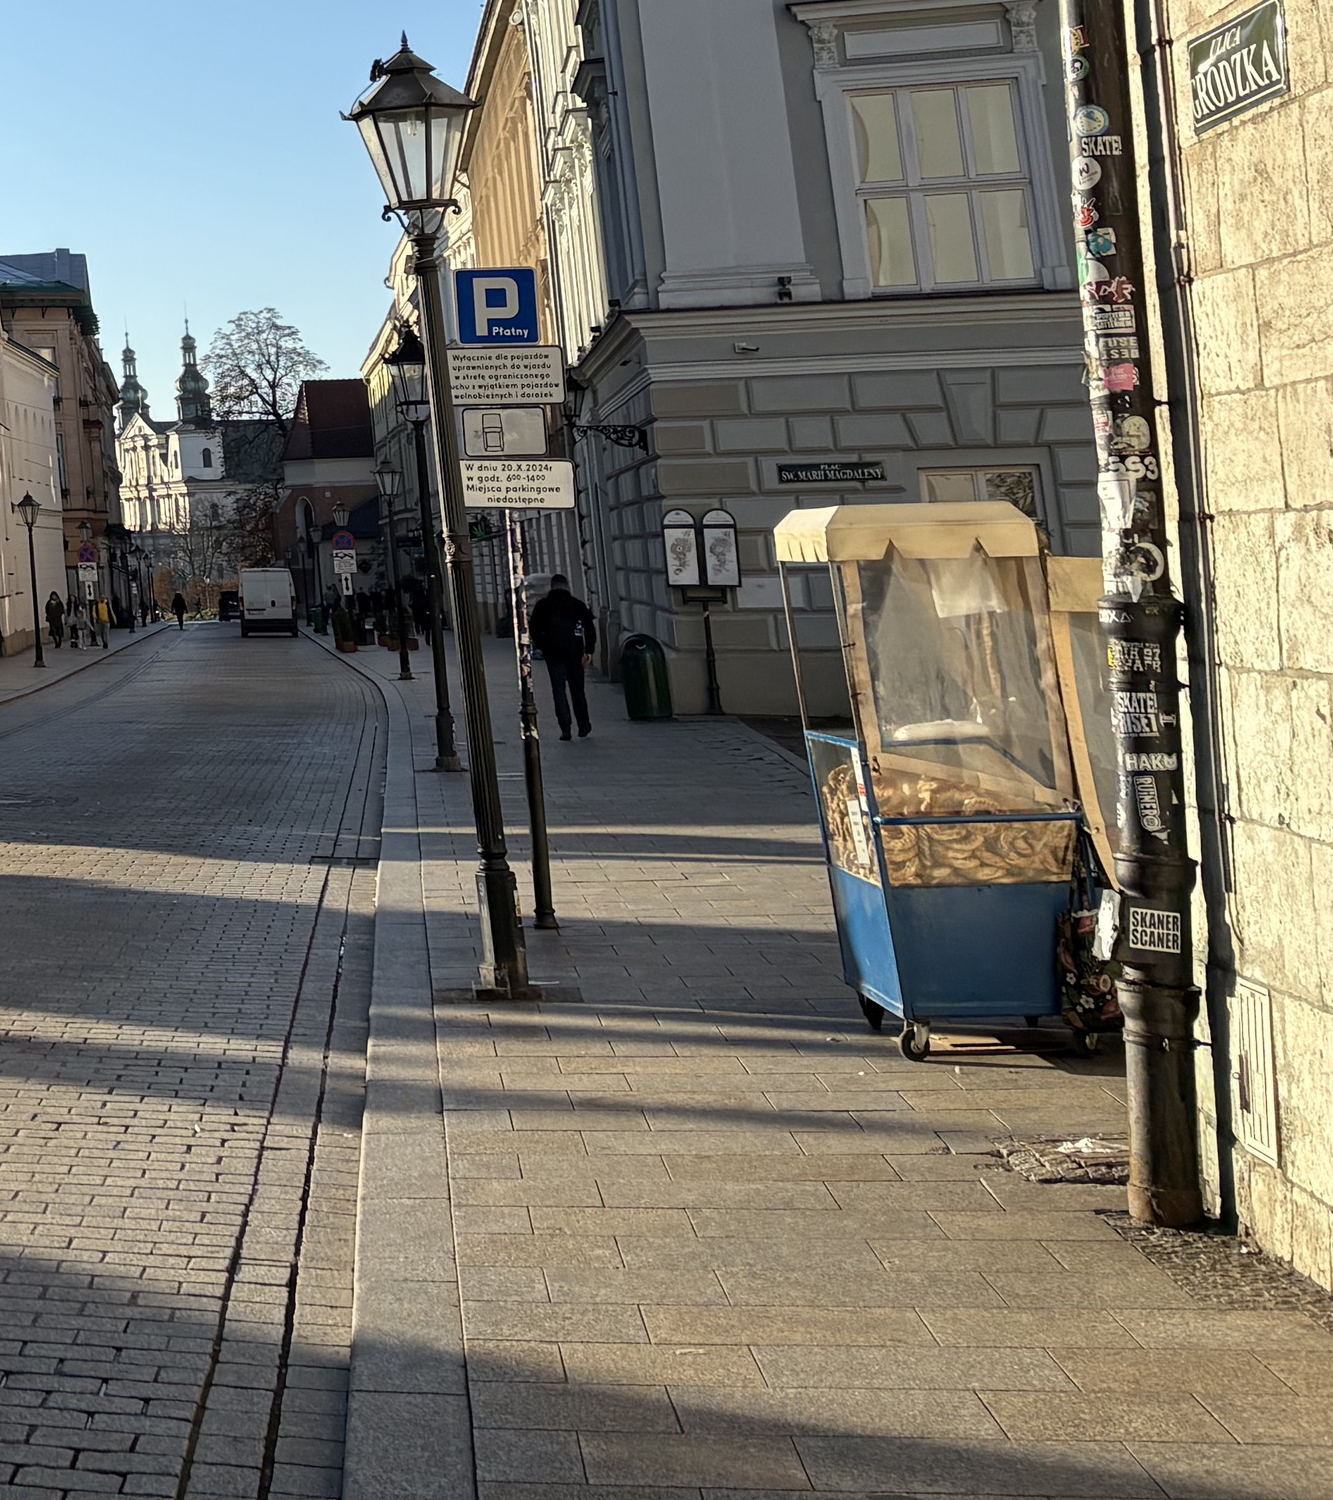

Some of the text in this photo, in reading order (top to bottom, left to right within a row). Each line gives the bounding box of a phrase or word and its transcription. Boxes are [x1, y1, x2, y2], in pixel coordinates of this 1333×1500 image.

[1210, 25, 1241, 57] ULICA
[1191, 40, 1281, 119] GRODZKA
[1082, 136, 1122, 156] SKATE!
[473, 277, 520, 336] P
[493, 327, 529, 338] Płatny
[452, 352, 549, 363] Wyłącznie dla pojazdów
[452, 362, 551, 372] uprawnionych do wjazdu
[488, 372, 550, 381] ograniczonego
[521, 381, 560, 390] pojazdów
[464, 463, 474, 471] W
[477, 463, 498, 471] dniu
[477, 474, 503, 484] godz.
[798, 470, 825, 480] MARII
[826, 468, 883, 480] MAGDALENY
[466, 484, 561, 495] Miejsca parkingowe
[487, 495, 546, 505] niedostępne
[1117, 691, 1158, 713] SKATE!
[1131, 910, 1180, 930] SKANER
[1131, 928, 1180, 951] SCANER
